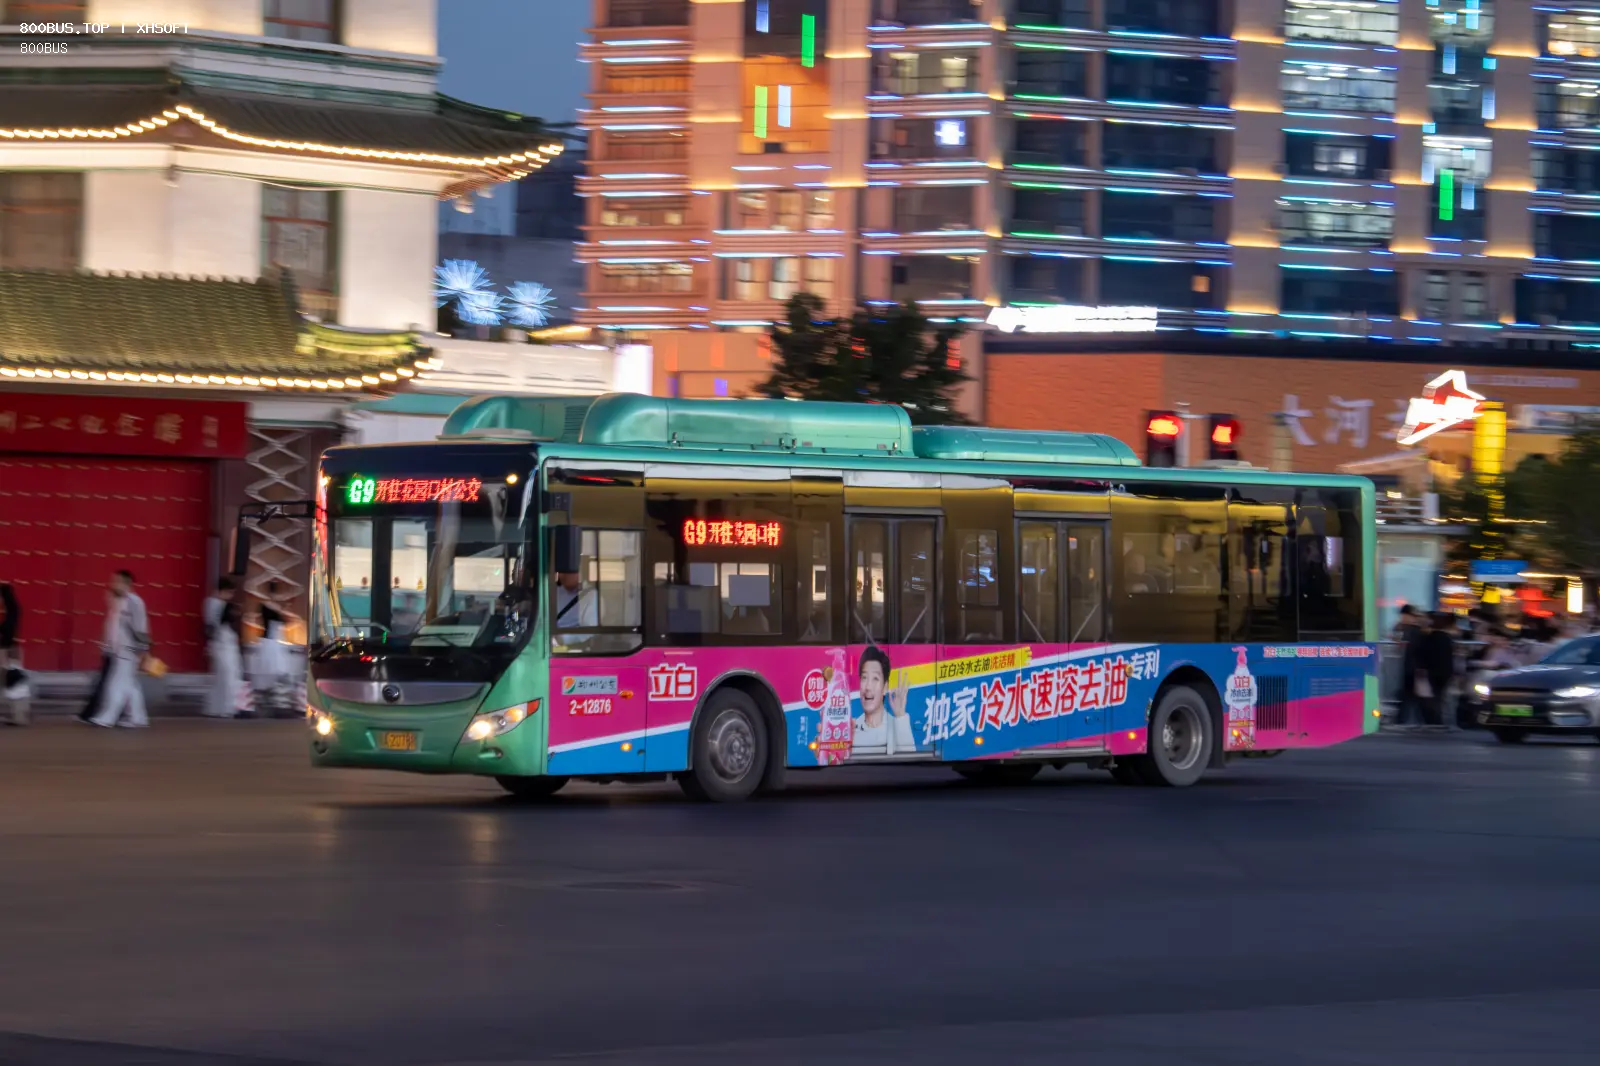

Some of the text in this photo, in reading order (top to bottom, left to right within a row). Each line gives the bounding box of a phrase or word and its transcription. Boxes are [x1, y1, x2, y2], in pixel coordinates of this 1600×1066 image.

[349, 478, 375, 503] G9
[683, 519, 707, 545] G9
[938, 653, 1016, 679] 立白冷水去油洗洁精
[649, 663, 697, 701] 立白
[569, 698, 612, 715] 2-12876
